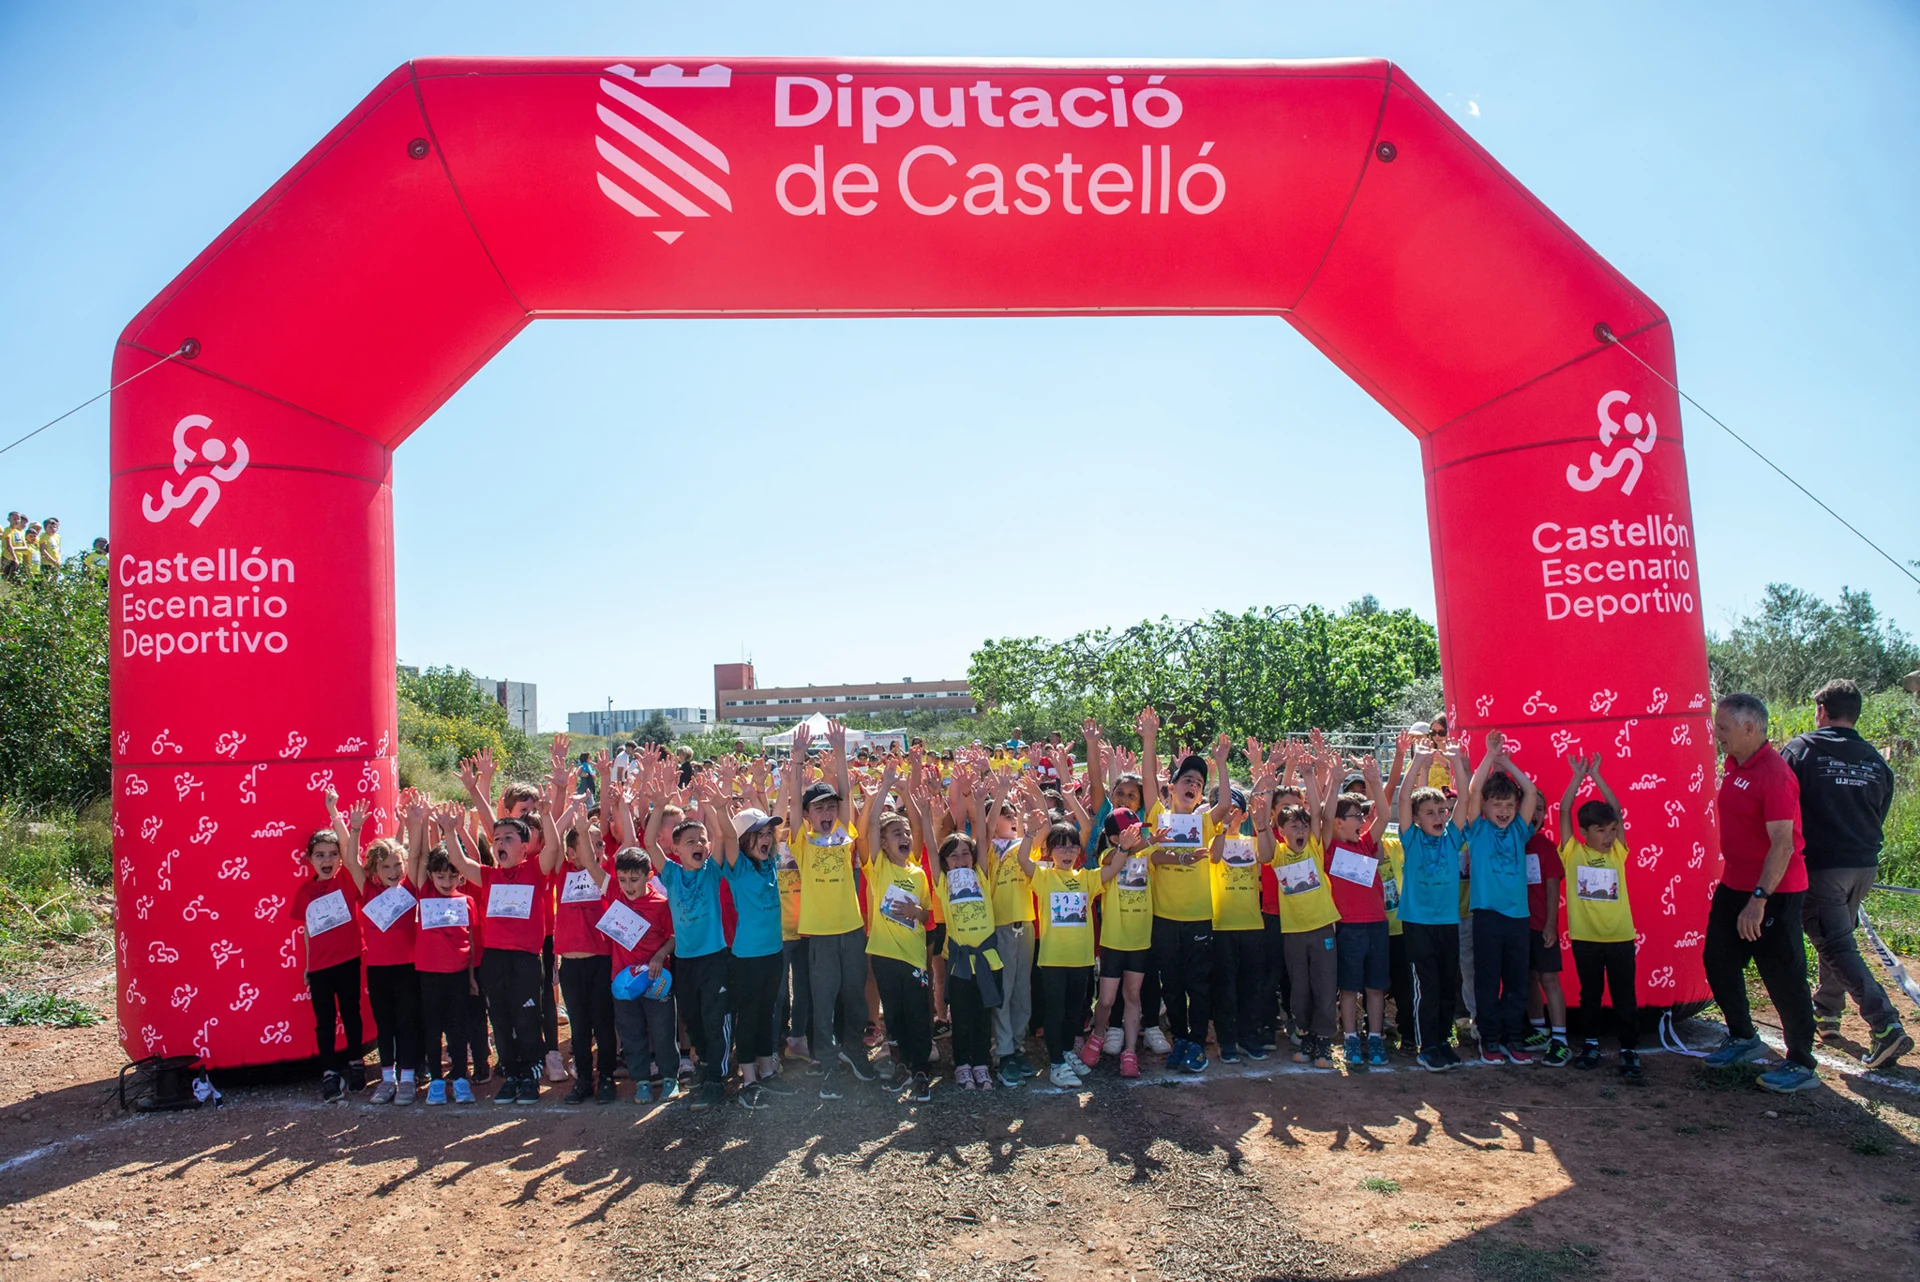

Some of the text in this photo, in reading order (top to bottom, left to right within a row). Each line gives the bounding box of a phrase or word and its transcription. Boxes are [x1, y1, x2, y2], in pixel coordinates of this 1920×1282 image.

[775, 74, 1184, 143] Diputació
[775, 141, 1226, 216] de Castelló
[1532, 513, 1690, 554] Castellón
[119, 546, 295, 587] Castellón
[1541, 550, 1690, 587] Escenario
[122, 585, 288, 622] Escenario
[1545, 582, 1694, 623] Deportivo
[123, 621, 288, 662] Deportivo
[1733, 776, 1750, 790] UJI
